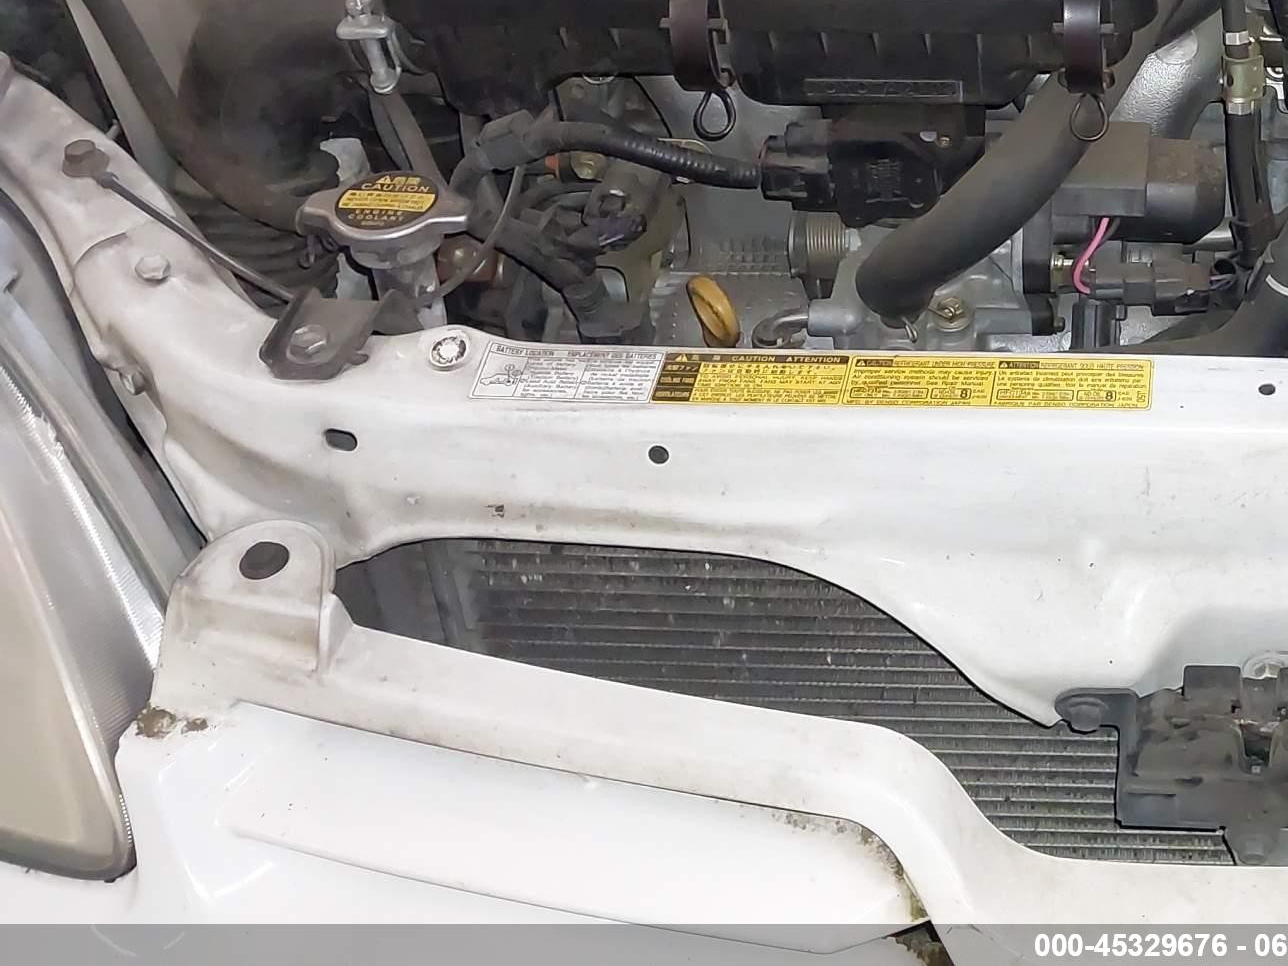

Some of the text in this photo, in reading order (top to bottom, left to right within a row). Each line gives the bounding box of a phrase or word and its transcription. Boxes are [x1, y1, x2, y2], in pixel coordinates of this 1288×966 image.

[361, 182, 430, 193] CAUTION
[960, 389, 968, 399] 8
[1106, 391, 1113, 400] 8
